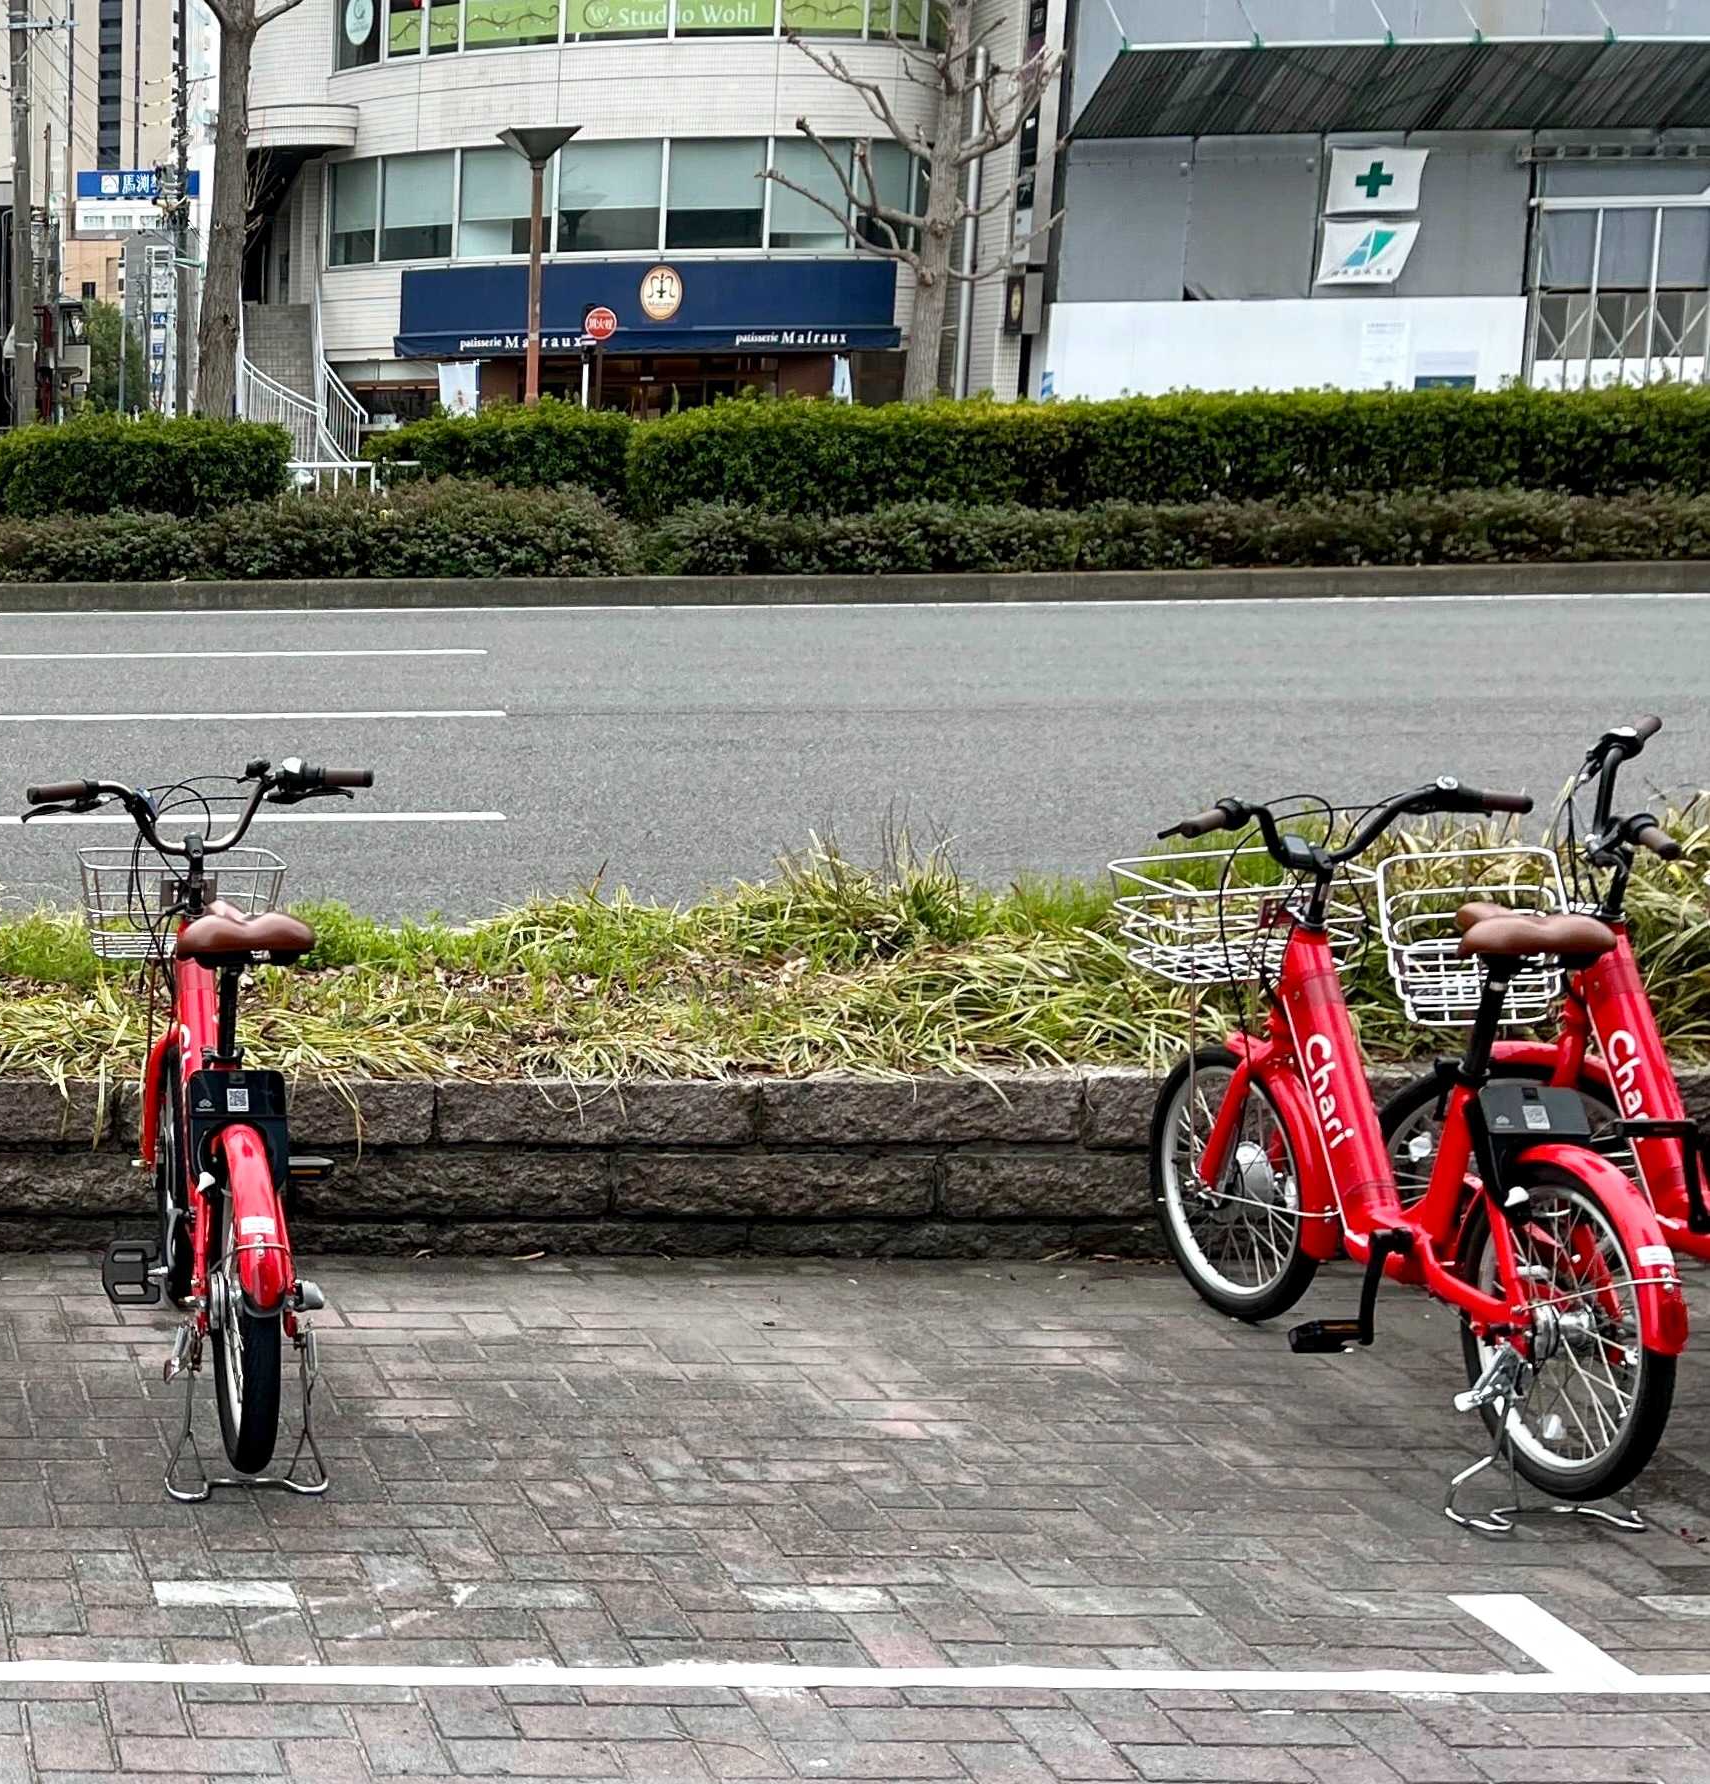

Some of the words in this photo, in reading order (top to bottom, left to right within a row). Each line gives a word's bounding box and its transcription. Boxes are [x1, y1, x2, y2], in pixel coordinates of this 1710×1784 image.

[618, 4, 694, 26] Studio
[701, 2, 756, 24] Wohl
[459, 335, 502, 351] patisserie
[504, 335, 582, 349] Maraux
[735, 331, 779, 346] patisserie
[780, 330, 847, 344] Malraux
[1305, 1033, 1355, 1149] Chari
[1608, 1029, 1650, 1143] Cha
